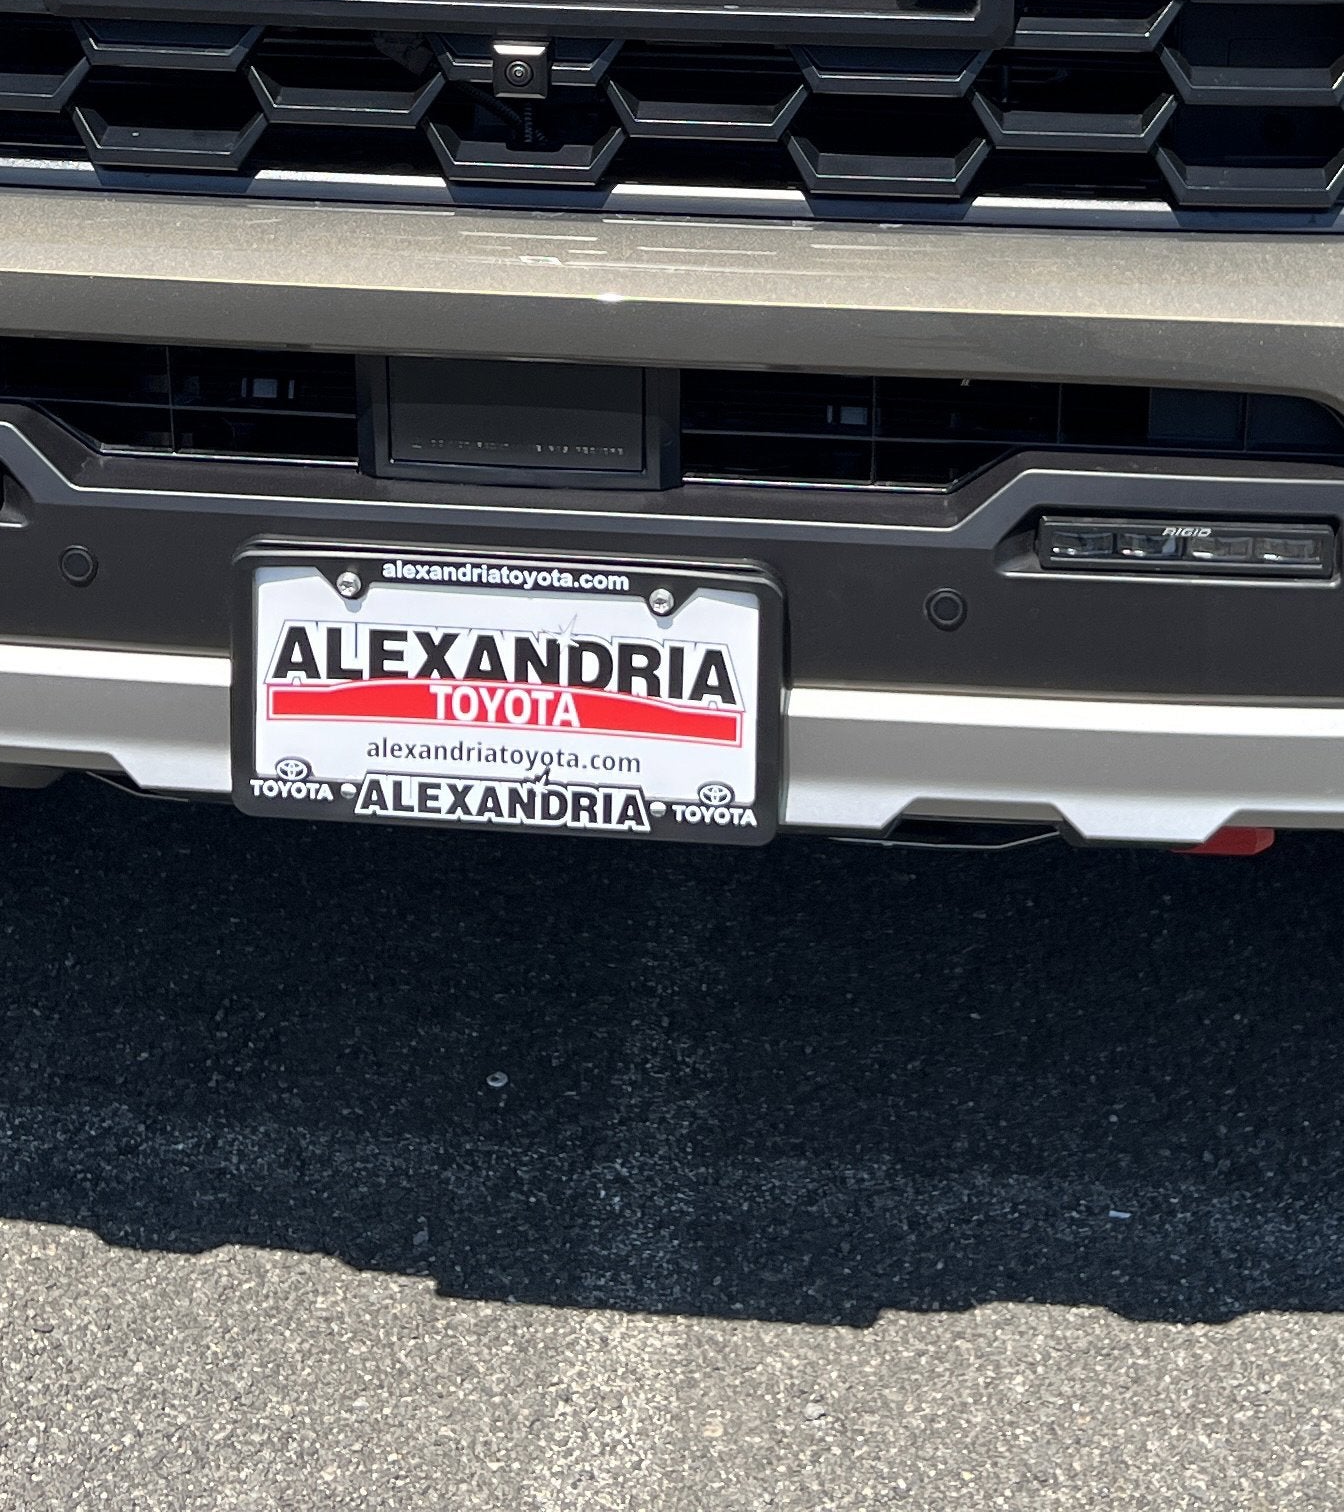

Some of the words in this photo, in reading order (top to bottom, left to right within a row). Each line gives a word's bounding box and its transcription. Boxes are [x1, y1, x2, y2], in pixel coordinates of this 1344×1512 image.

[1162, 527, 1212, 537] RIGID
[382, 560, 630, 591] alexandriatoyota.com
[272, 625, 738, 706] ALEXANDRIA
[429, 684, 580, 728] TOYOTA
[366, 737, 641, 773] alexandriatoyota.com
[249, 778, 334, 801] TOYOTA
[359, 778, 647, 828] ALEXANDRIA
[672, 804, 758, 827] TOYOTA
